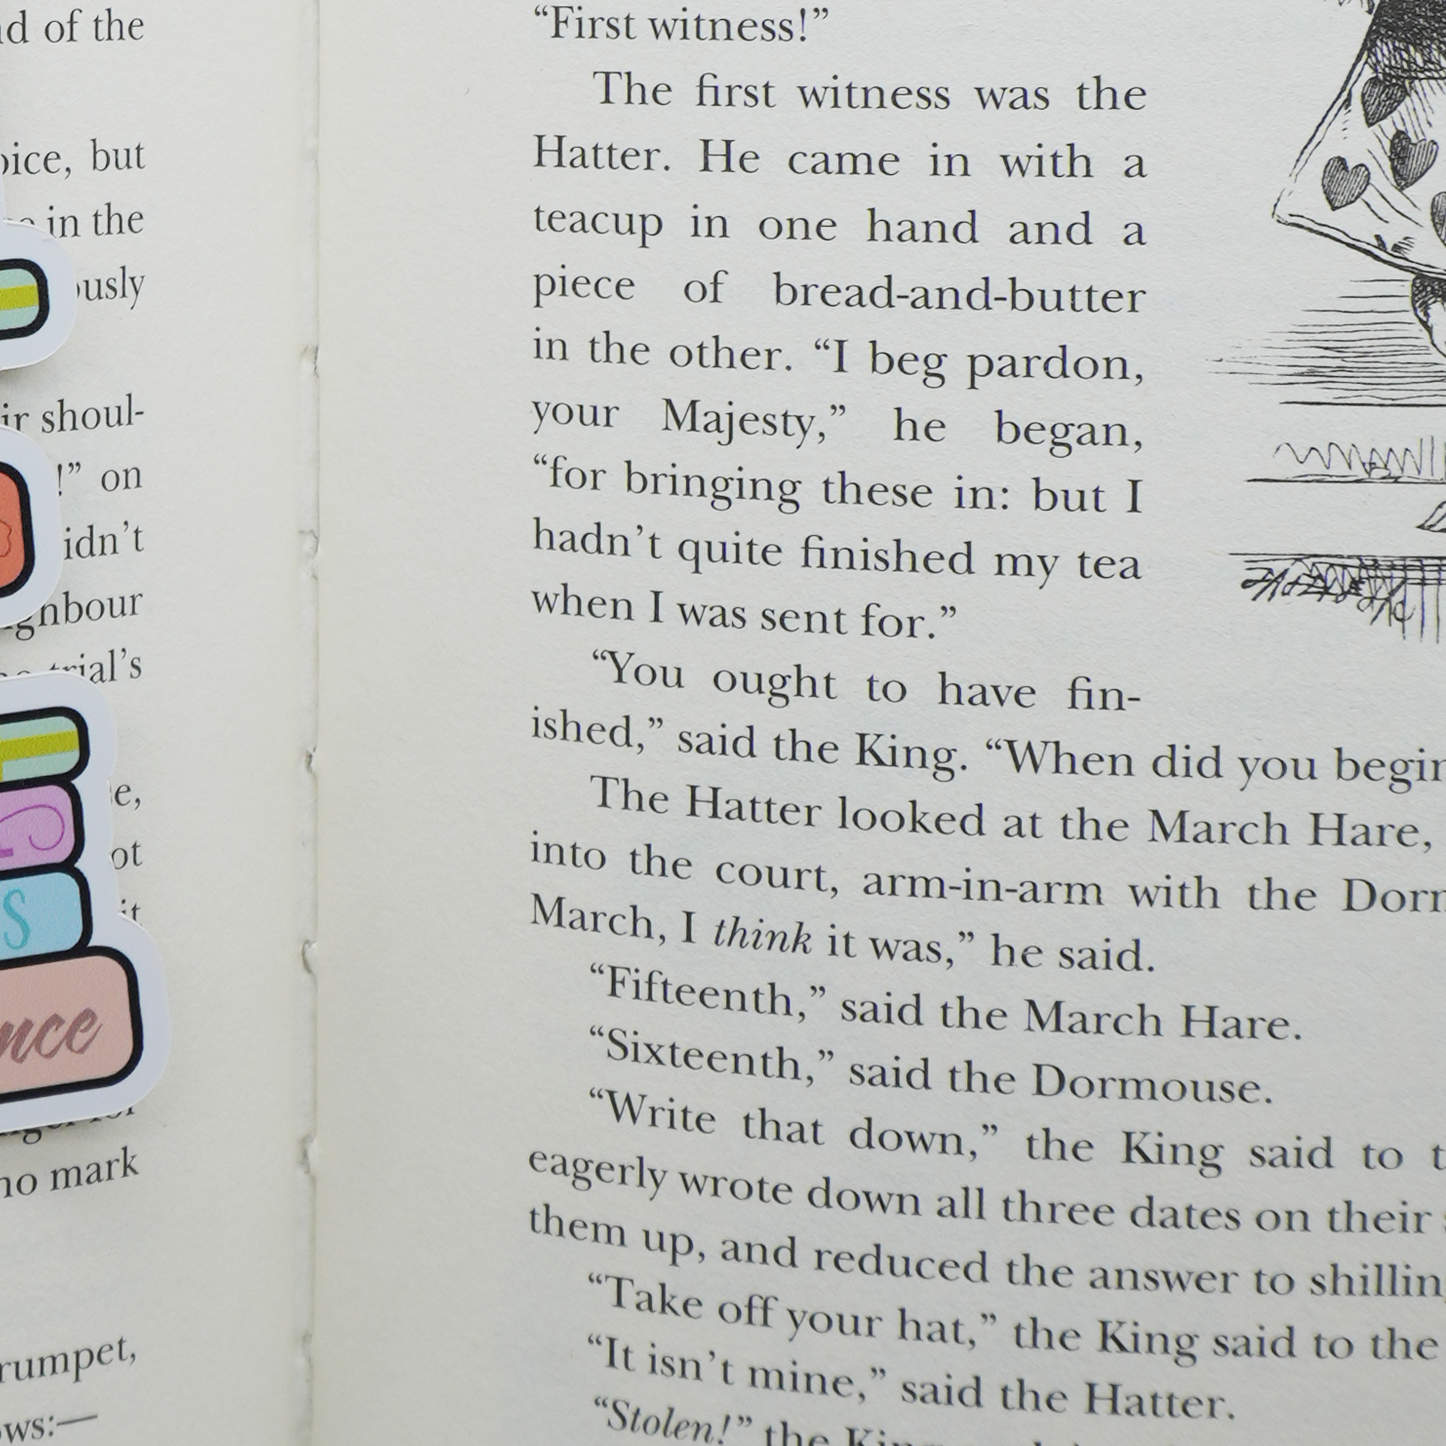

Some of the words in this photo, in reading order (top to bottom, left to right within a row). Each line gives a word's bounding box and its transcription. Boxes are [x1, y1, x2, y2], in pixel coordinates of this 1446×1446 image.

[45, 8, 82, 43] of
[93, 8, 144, 41] the
[535, 5, 637, 40] “First
[648, 7, 828, 42] witness!”
[534, 135, 670, 171] Hatter.
[699, 139, 759, 173] He
[788, 152, 900, 176] came
[929, 142, 971, 176] in
[999, 143, 1094, 178] with
[1124, 155, 1148, 178] a
[533, 264, 635, 308] piece
[684, 270, 728, 303] of
[773, 271, 1146, 313] bread-and-butter
[42, 393, 144, 433] shoul-
[534, 454, 606, 490] “for
[624, 460, 802, 514] bringing
[822, 470, 933, 508] these
[954, 475, 1008, 510] in:
[1031, 477, 1107, 512] but
[1127, 479, 1143, 513] I
[531, 583, 634, 621] when
[650, 590, 663, 623] I
[677, 603, 746, 629] was
[761, 608, 848, 635] sent
[861, 603, 956, 639] for.”
[590, 775, 669, 814] The
[686, 784, 822, 827] Hatter
[838, 796, 986, 836] looked
[1004, 812, 1043, 839] at
[1061, 807, 1129, 841] the
[1148, 809, 1289, 845] March
[1309, 812, 1431, 853] Hare,
[531, 893, 665, 946] March,
[682, 911, 695, 943] I
[714, 916, 811, 954] think
[828, 924, 856, 958] it
[869, 931, 974, 970] was,”
[991, 933, 1043, 967] he
[1059, 938, 1154, 972] said.
[590, 1025, 833, 1087] “Sixteenth,”
[850, 1056, 932, 1090] said
[949, 1060, 1015, 1094] the
[1032, 1063, 1272, 1104] Dormouse.
[50, 1145, 141, 1193] mark
[530, 1203, 626, 1247] them
[643, 1229, 705, 1267] up,
[721, 1236, 798, 1268] and
[815, 1243, 989, 1283] reduced
[1007, 1253, 1073, 1288] the
[1090, 1267, 1239, 1293] answer
[1255, 1269, 1295, 1295] to
[588, 1334, 634, 1371] “It
[649, 1343, 733, 1385] isn’t
[749, 1360, 885, 1402] mine,”
[902, 1373, 983, 1408] said
[1001, 1378, 1068, 1413] the
[1086, 1382, 1234, 1419] Hatter.
